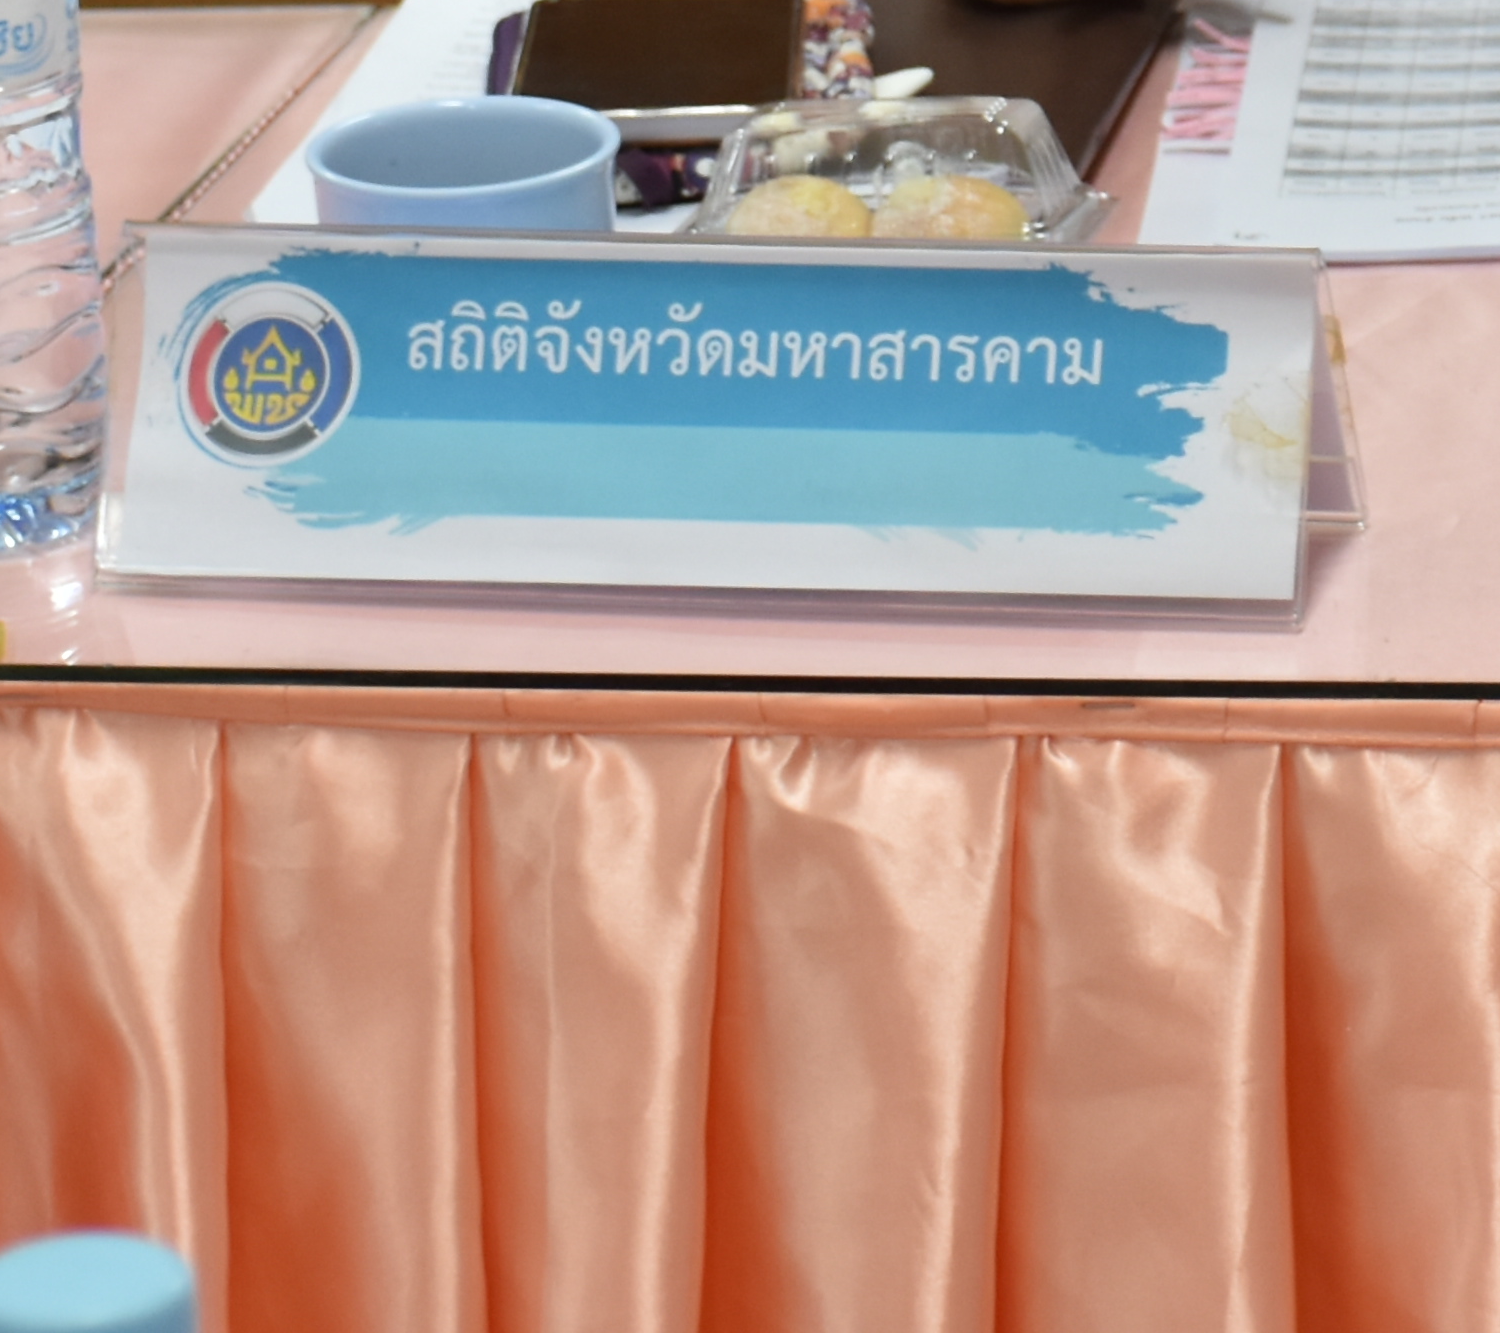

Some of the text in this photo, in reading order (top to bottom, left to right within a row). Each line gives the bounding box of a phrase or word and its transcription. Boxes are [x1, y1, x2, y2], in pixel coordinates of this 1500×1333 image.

[407, 298, 1104, 386] สถิติจังหวัดมหาสารคาม
